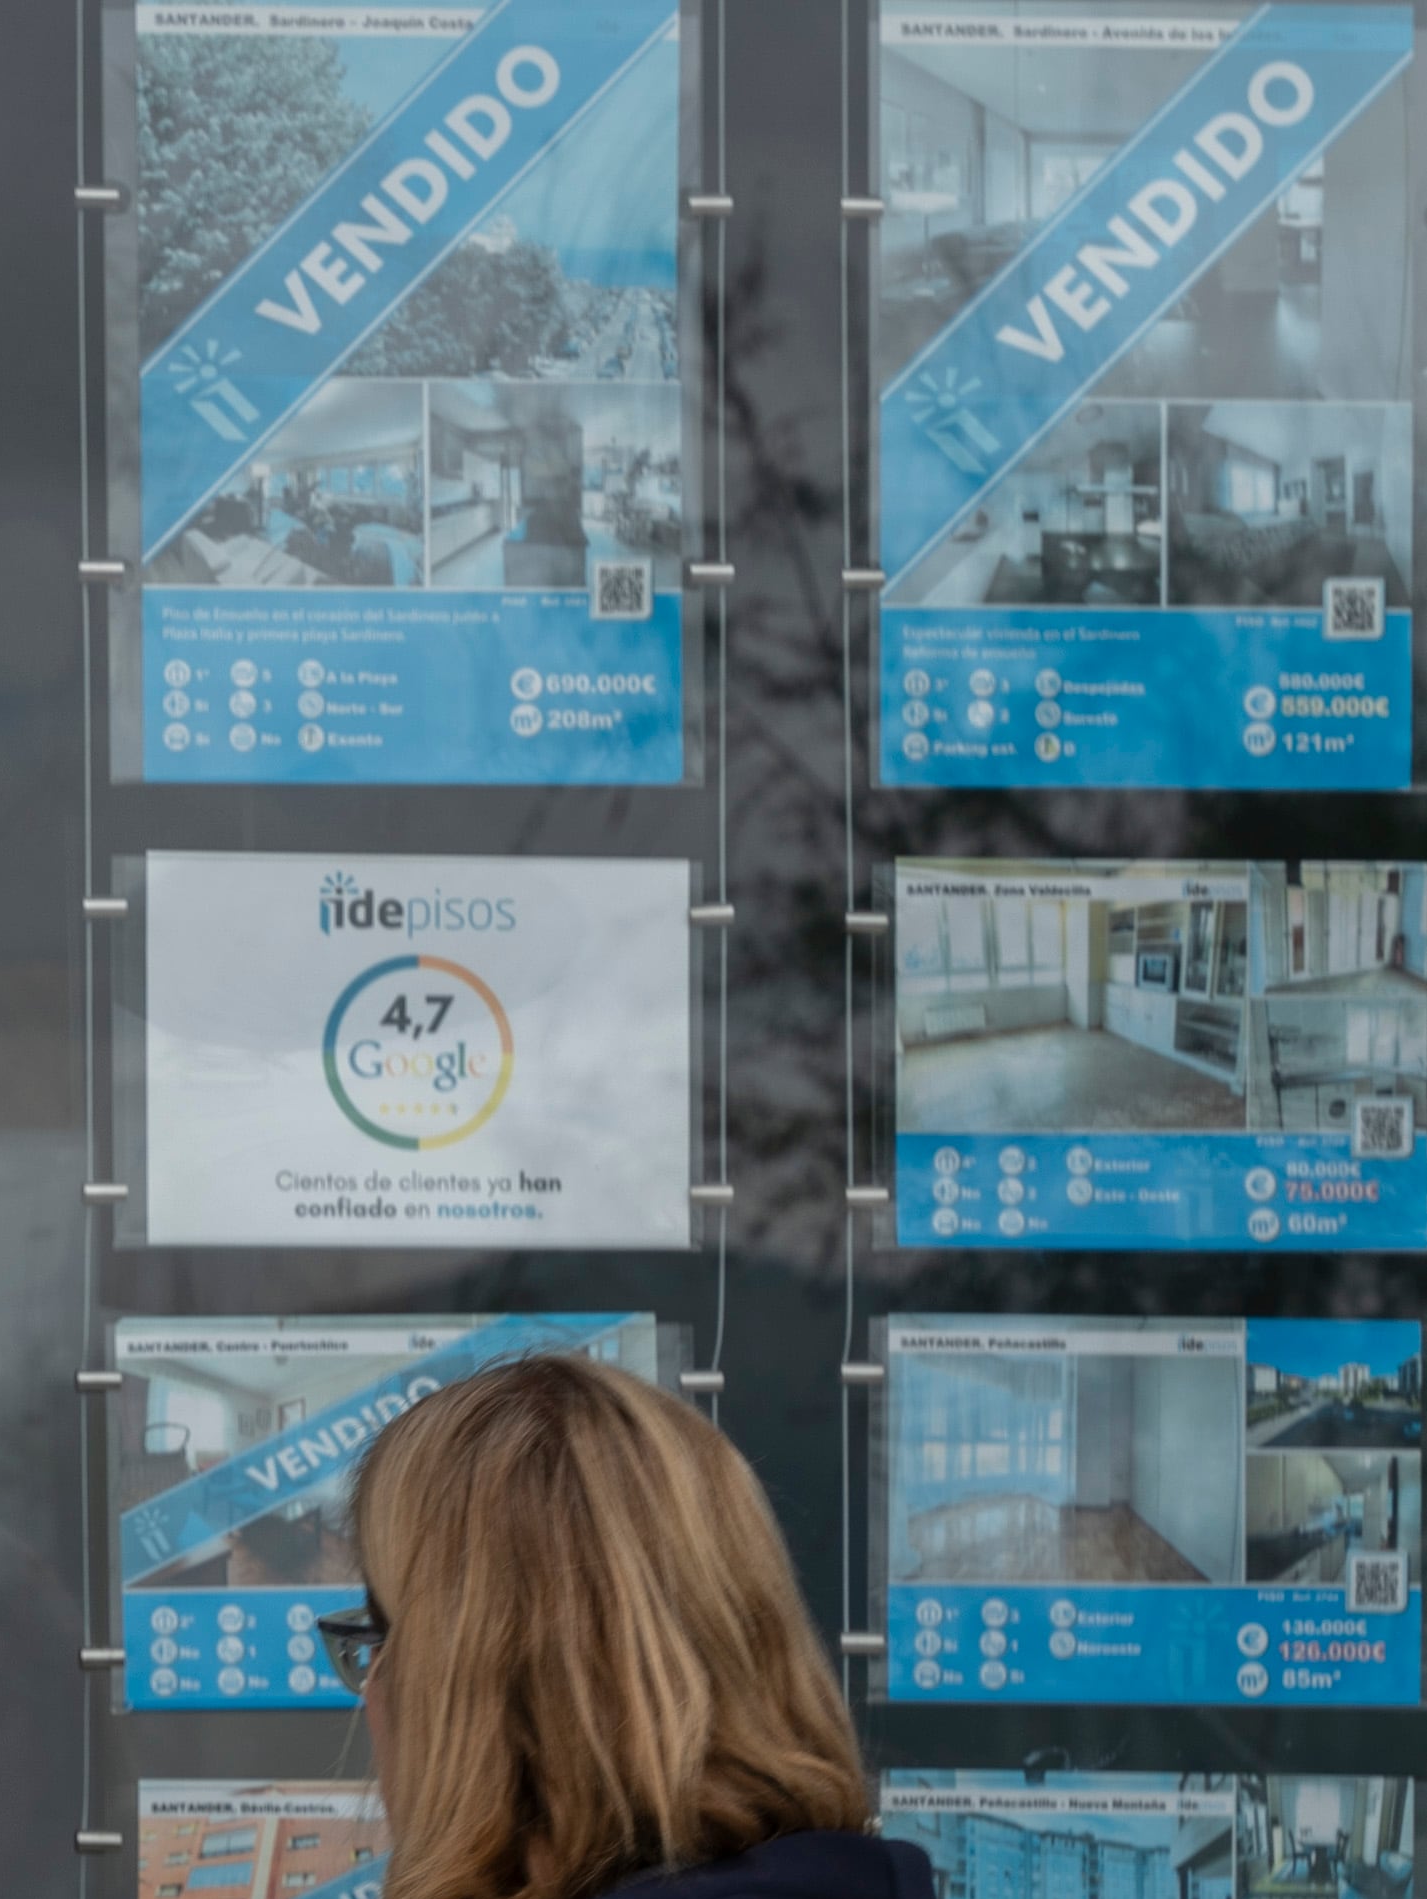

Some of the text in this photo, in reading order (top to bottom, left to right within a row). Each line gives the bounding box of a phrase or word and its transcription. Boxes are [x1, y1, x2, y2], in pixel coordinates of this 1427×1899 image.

[901, 24, 1213, 42] SANTANDER. Sardinero Avenida de los
[255, 46, 560, 336] VENDIDO
[995, 61, 1314, 363] VENDIDO
[547, 674, 656, 695] 690.000€
[547, 710, 622, 730] 208m²
[1282, 733, 1354, 753] 121m²
[333, 888, 516, 940] idepisos
[380, 994, 455, 1040] 4,7
[348, 1040, 487, 1092] Google
[275, 1170, 562, 1196] Cientos de clientes ya han
[295, 1197, 543, 1219] confiado en nosotros.
[1288, 1215, 1347, 1234] 60m²
